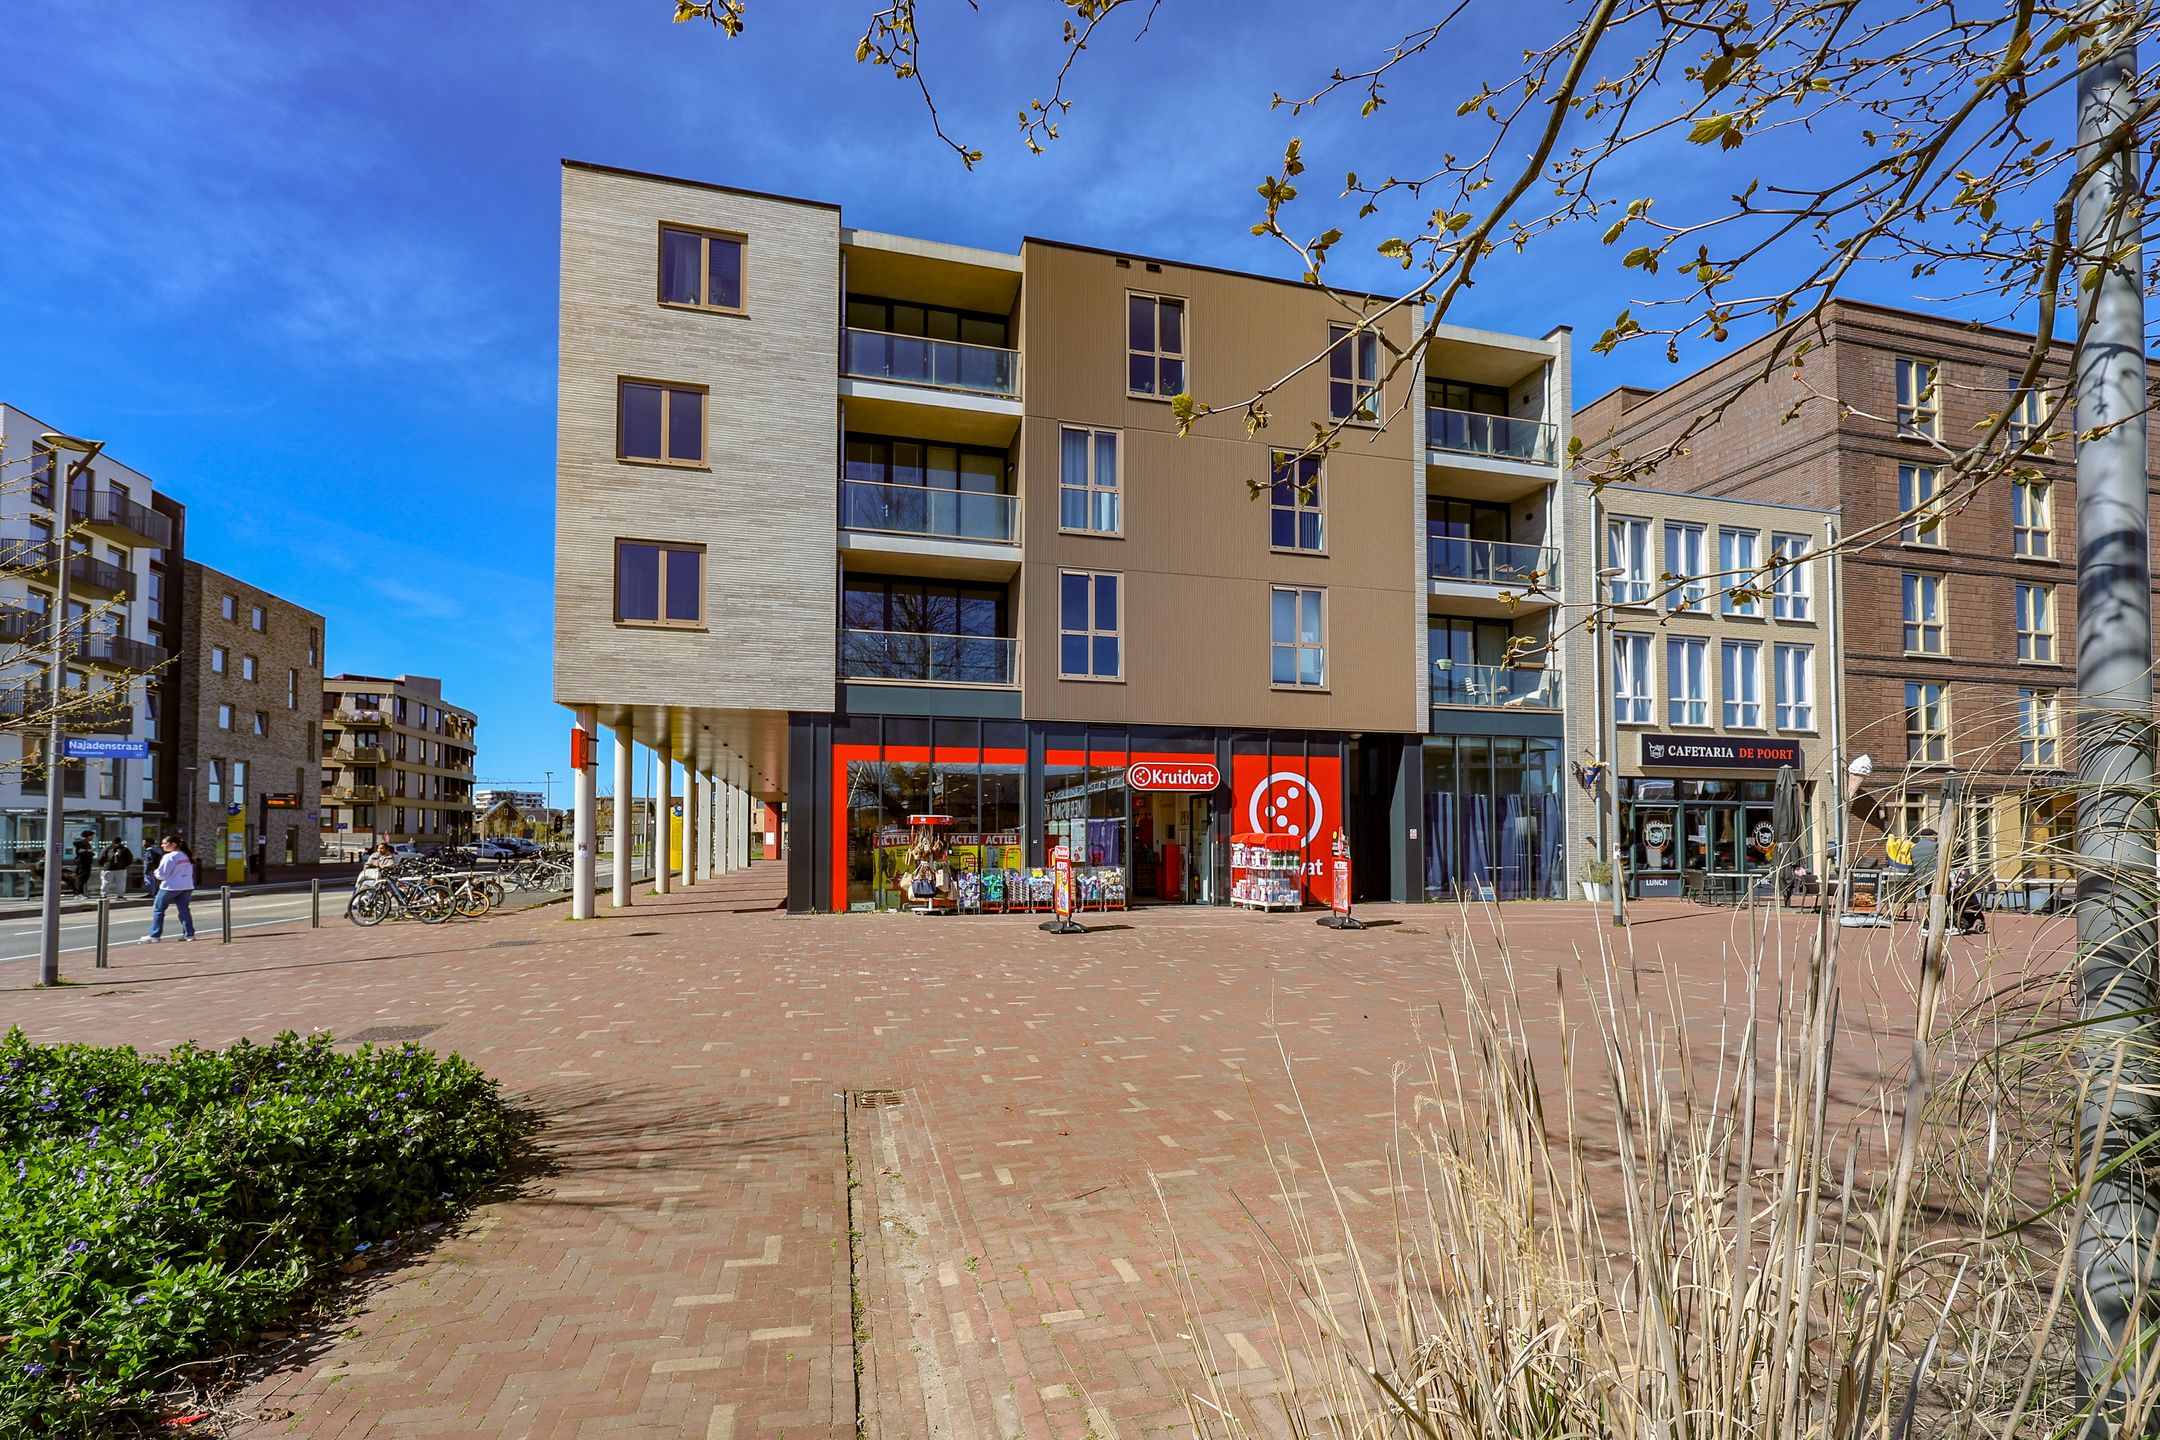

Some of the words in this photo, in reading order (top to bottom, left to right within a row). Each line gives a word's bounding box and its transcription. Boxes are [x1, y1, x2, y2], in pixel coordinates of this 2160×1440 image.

[69, 741, 144, 751] Najadenstraat
[1668, 745, 1734, 758] CAFETARIA
[1739, 748, 1754, 759] DE
[1757, 748, 1793, 760] POORT
[1152, 769, 1214, 785] Kruidvat
[950, 835, 978, 845] ACTIE
[986, 835, 1017, 845] ACTIE!
